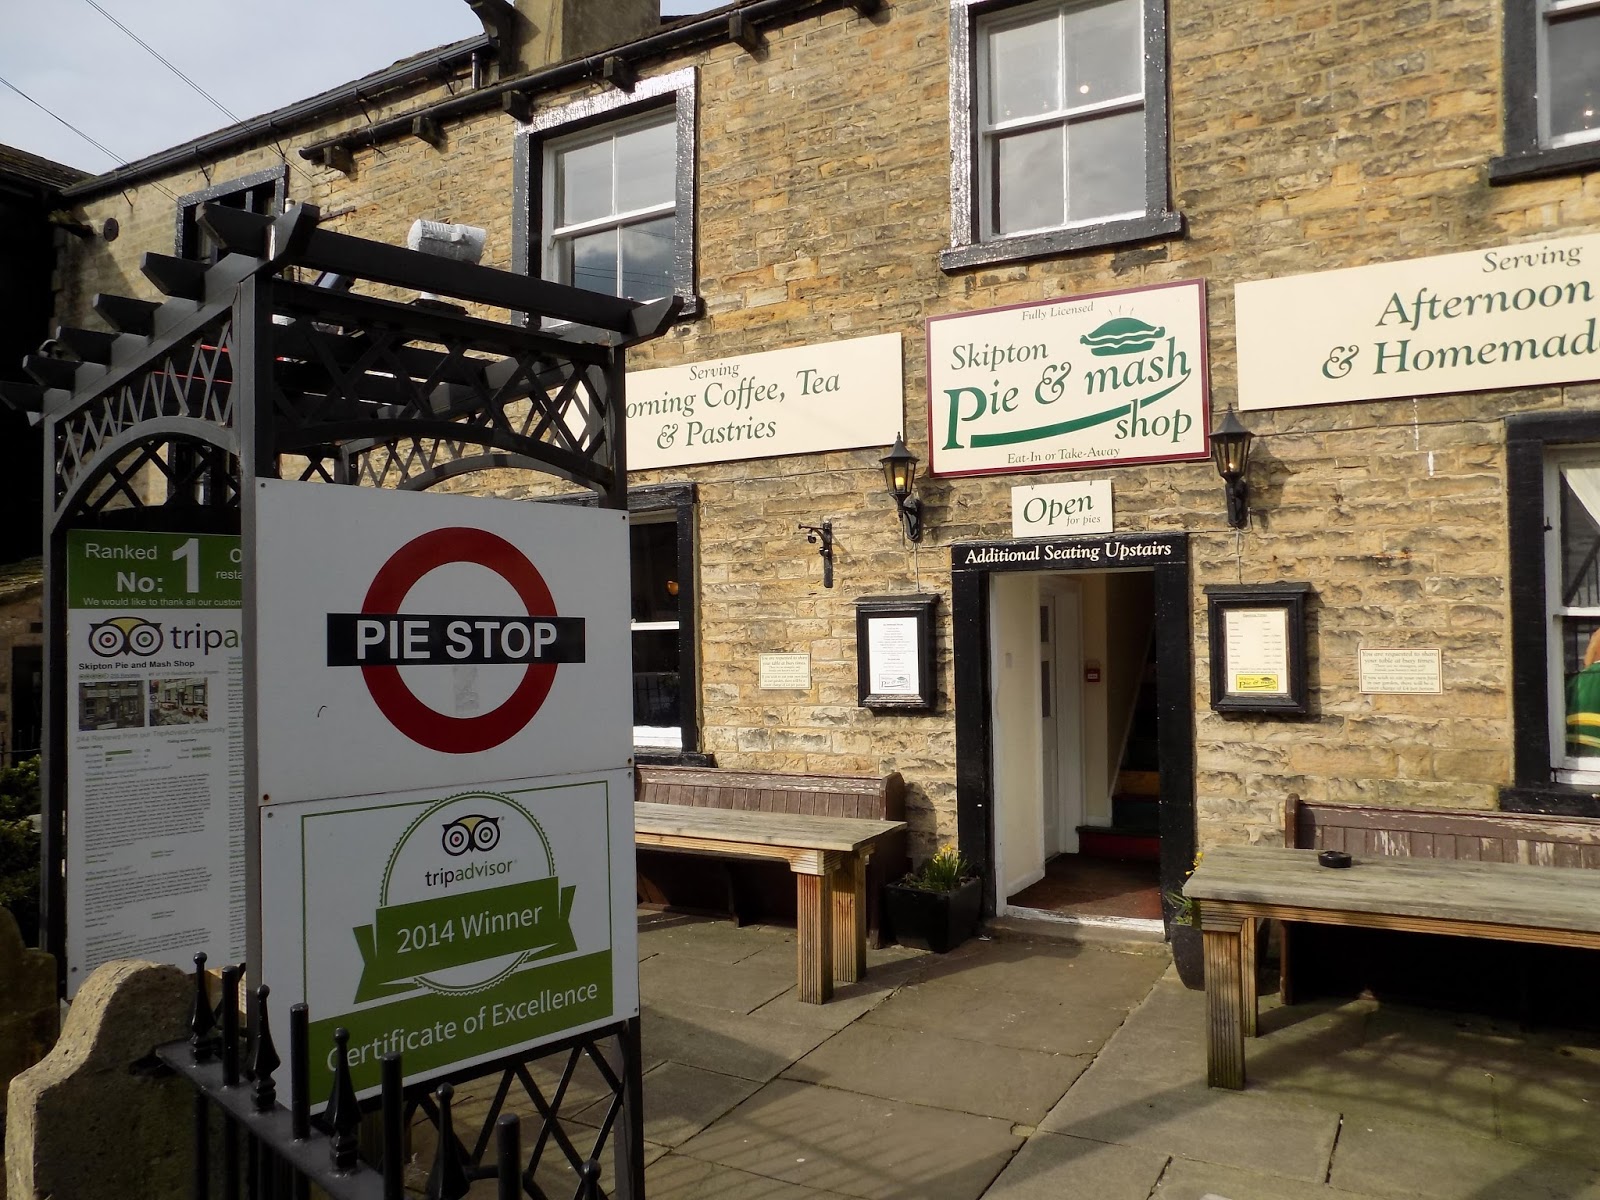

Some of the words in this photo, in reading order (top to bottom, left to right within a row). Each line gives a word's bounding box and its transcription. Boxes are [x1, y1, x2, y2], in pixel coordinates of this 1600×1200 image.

[1482, 245, 1583, 274] Serving
[1021, 309, 1047, 321] Fully
[1050, 301, 1094, 318] Licensed
[1375, 280, 1594, 331] Afternoon
[951, 342, 1049, 372] Skipton
[1322, 344, 1359, 379] &
[1373, 318, 1600, 375] Homemad
[689, 362, 740, 381] Serving
[625, 391, 697, 419] orning
[703, 376, 785, 410] Coffee,
[796, 368, 840, 396] Tea
[942, 379, 1019, 451] Pie
[1035, 362, 1071, 405] &
[1084, 336, 1192, 395] mash
[656, 423, 679, 449] &
[686, 416, 776, 446] Pastries
[1114, 398, 1193, 443] shop
[1007, 451, 1041, 464] Eat-In
[1044, 453, 1056, 462] or
[1058, 446, 1120, 460] Take-Away
[1023, 495, 1093, 526] Open
[1066, 516, 1081, 527] for
[1083, 515, 1101, 526] pies
[85, 543, 158, 560] Ranked
[172, 538, 199, 594] 1
[965, 546, 1040, 565] Additional
[1044, 544, 1100, 562] Seating
[1105, 541, 1172, 558] Upstairs
[116, 571, 163, 593] No:
[84, 597, 99, 606] We
[101, 597, 129, 606] would
[131, 597, 146, 606] like
[149, 598, 158, 606] to
[160, 597, 184, 606] thank
[185, 598, 196, 606] all
[213, 598, 242, 606] custom
[170, 623, 242, 656] tripa
[356, 619, 431, 660] PIE
[445, 620, 558, 660] STOP
[79, 662, 113, 671] Skipton
[115, 661, 129, 669] Pie
[131, 661, 147, 669] and
[150, 660, 172, 668] Mash
[174, 660, 195, 669] Shop
[425, 858, 513, 888] tripadvisor
[397, 918, 455, 954] 2014
[461, 905, 543, 939] Winner
[463, 1007, 487, 1035] of
[493, 983, 598, 1027] Excellence
